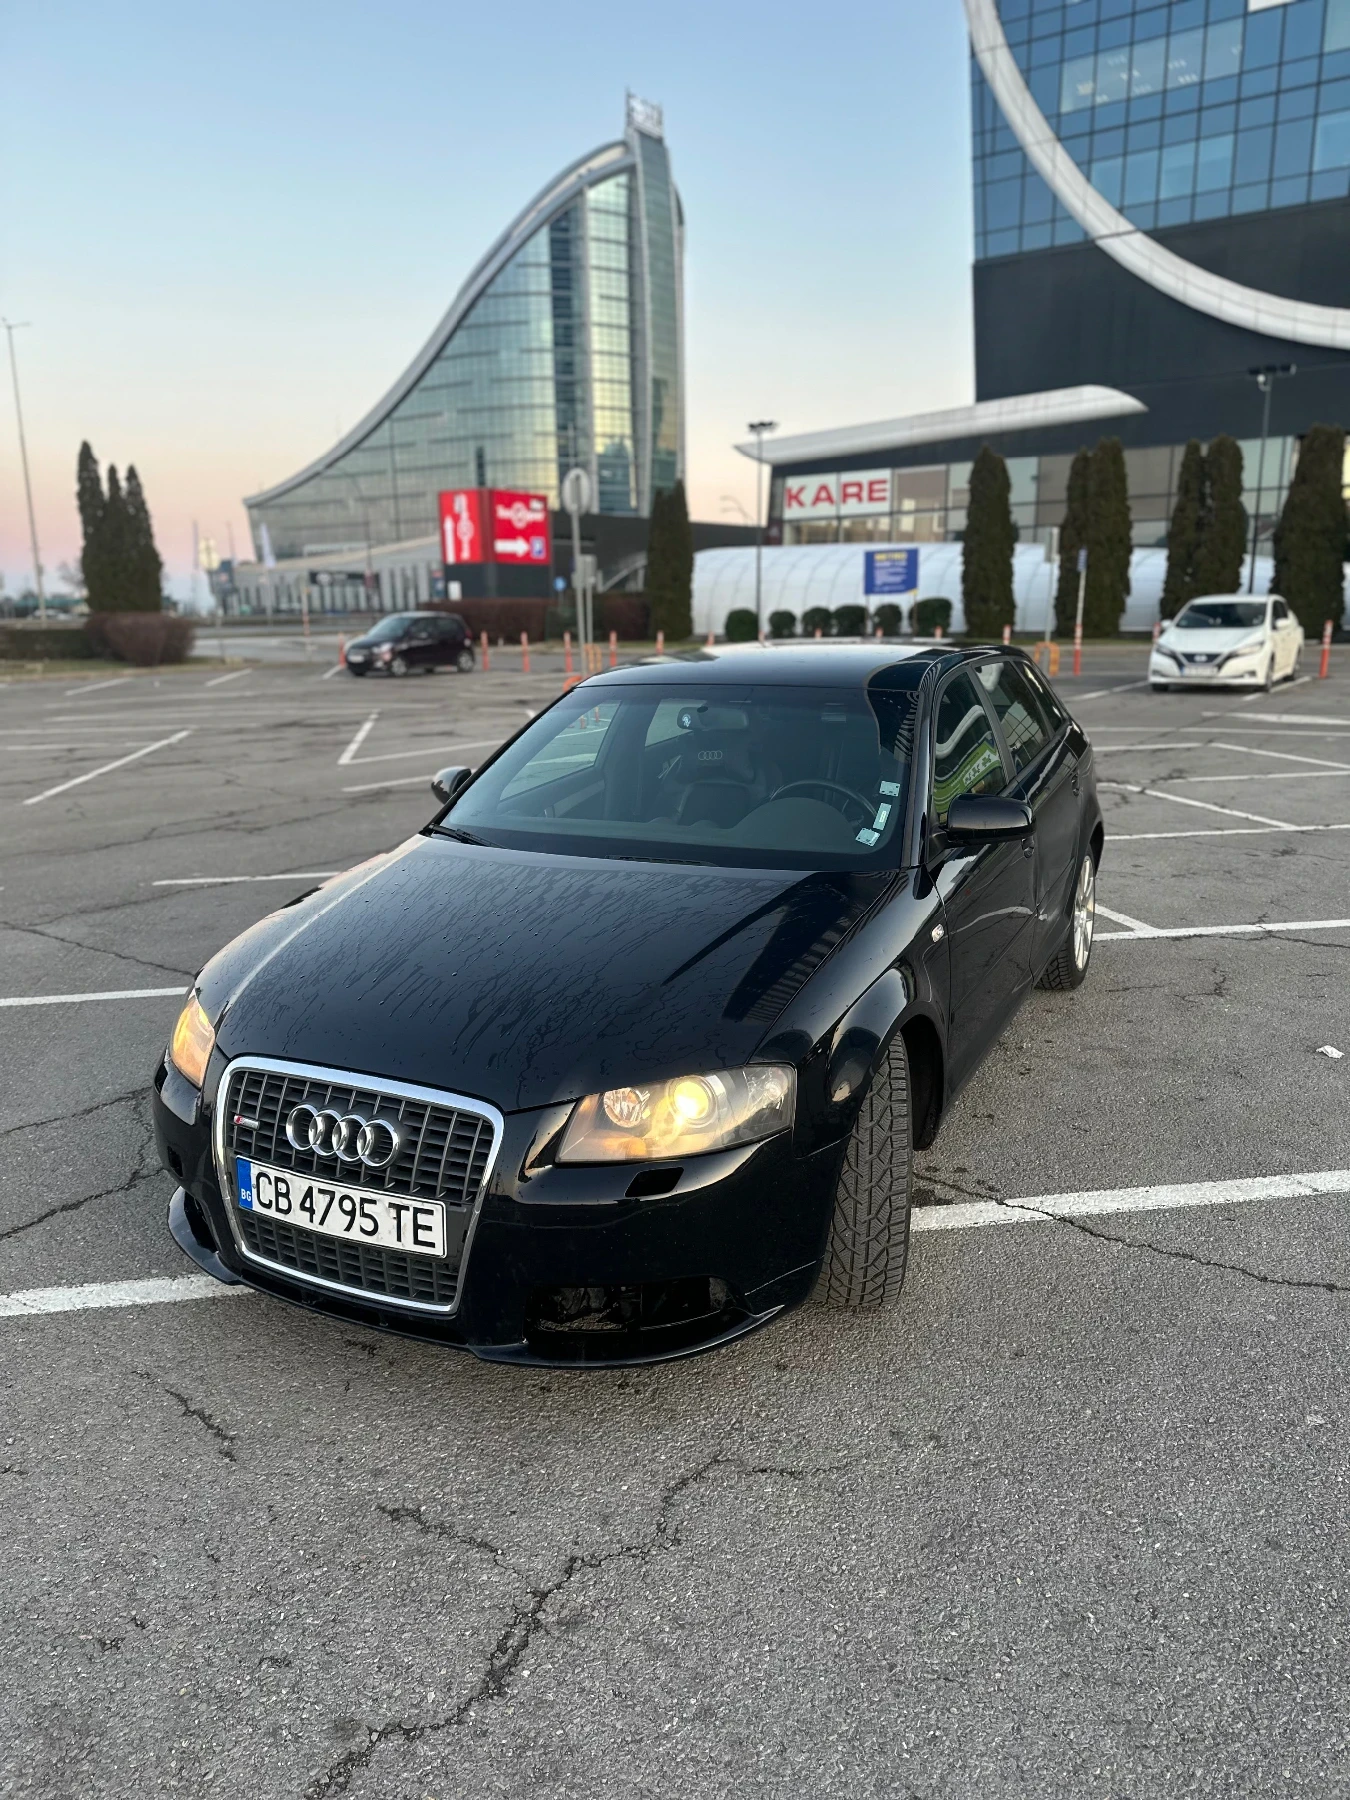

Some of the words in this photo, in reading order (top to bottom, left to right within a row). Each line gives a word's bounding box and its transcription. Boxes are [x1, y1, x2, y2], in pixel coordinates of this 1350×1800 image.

[785, 479, 888, 508] KARE
[240, 1188, 252, 1202] BG
[255, 1171, 292, 1215] CB
[299, 1185, 379, 1237] 4795
[388, 1202, 436, 1249] TE
